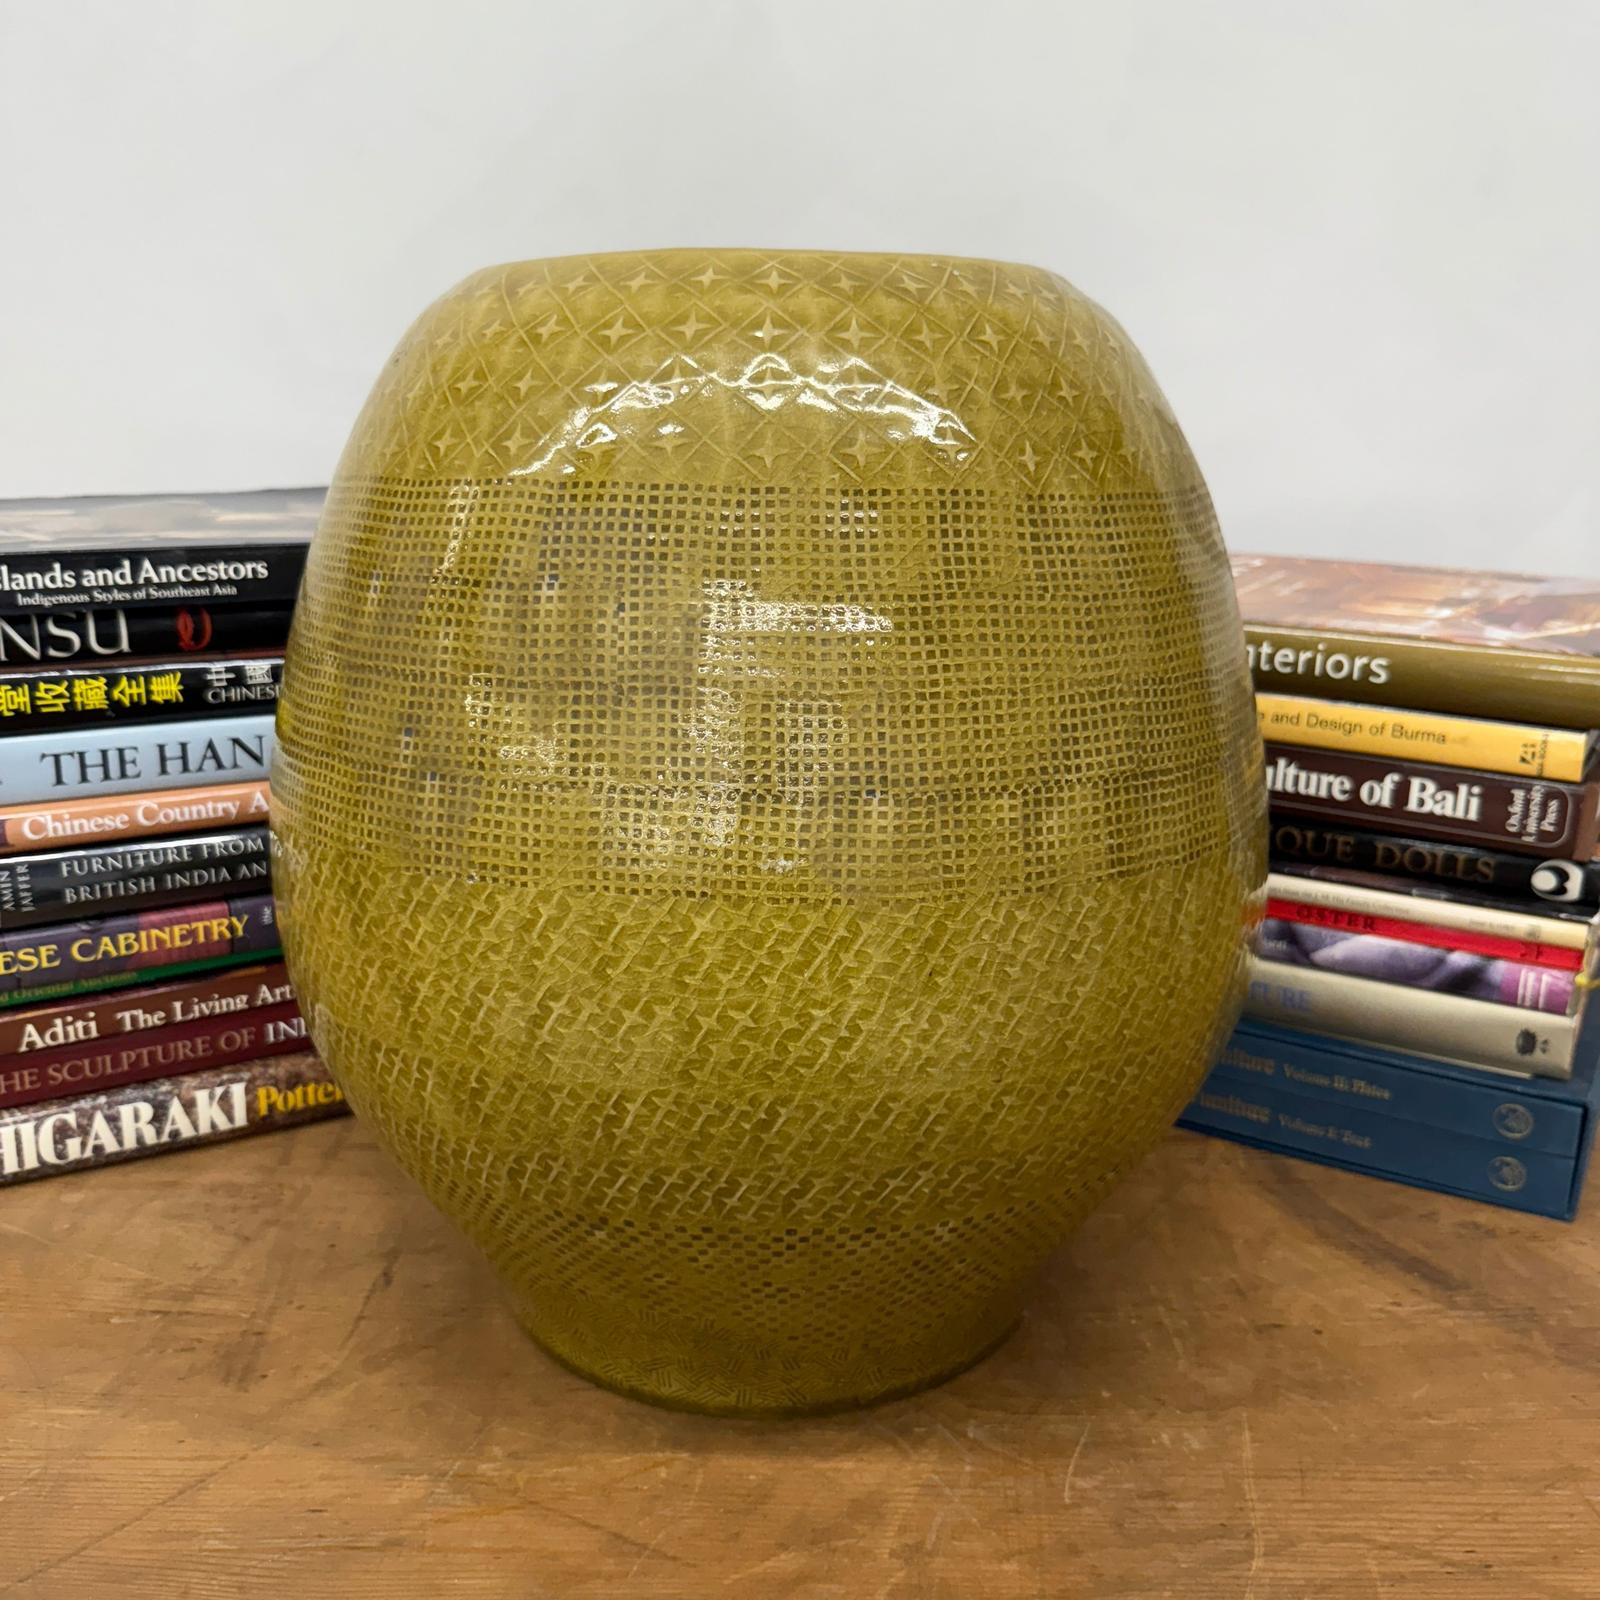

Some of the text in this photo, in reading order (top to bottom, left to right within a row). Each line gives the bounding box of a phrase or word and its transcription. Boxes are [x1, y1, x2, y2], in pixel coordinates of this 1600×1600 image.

[0, 557, 269, 591] lands and Ancestors
[17, 584, 237, 608] Indigenous Styles of Southeast Asia
[0, 608, 132, 662] NSU
[1271, 712, 1448, 745] and Design of Burma
[40, 735, 265, 787] THE HAN
[22, 812, 130, 841] Chinese
[136, 796, 240, 827] Country
[1360, 773, 1403, 808] of
[1404, 776, 1484, 822] Bali
[60, 837, 265, 878] FURNITURE FROM
[1374, 841, 1497, 884] DOLLS
[64, 876, 155, 904] BRITISH
[166, 866, 231, 890] INDIA
[0, 944, 61, 976] ESE
[70, 915, 248, 962] CABINETRY
[18, 983, 296, 1052] Aditi The Living Art
[0, 1068, 41, 1095] HE
[48, 1035, 212, 1086] SCULPTURE
[219, 1027, 256, 1051] OF
